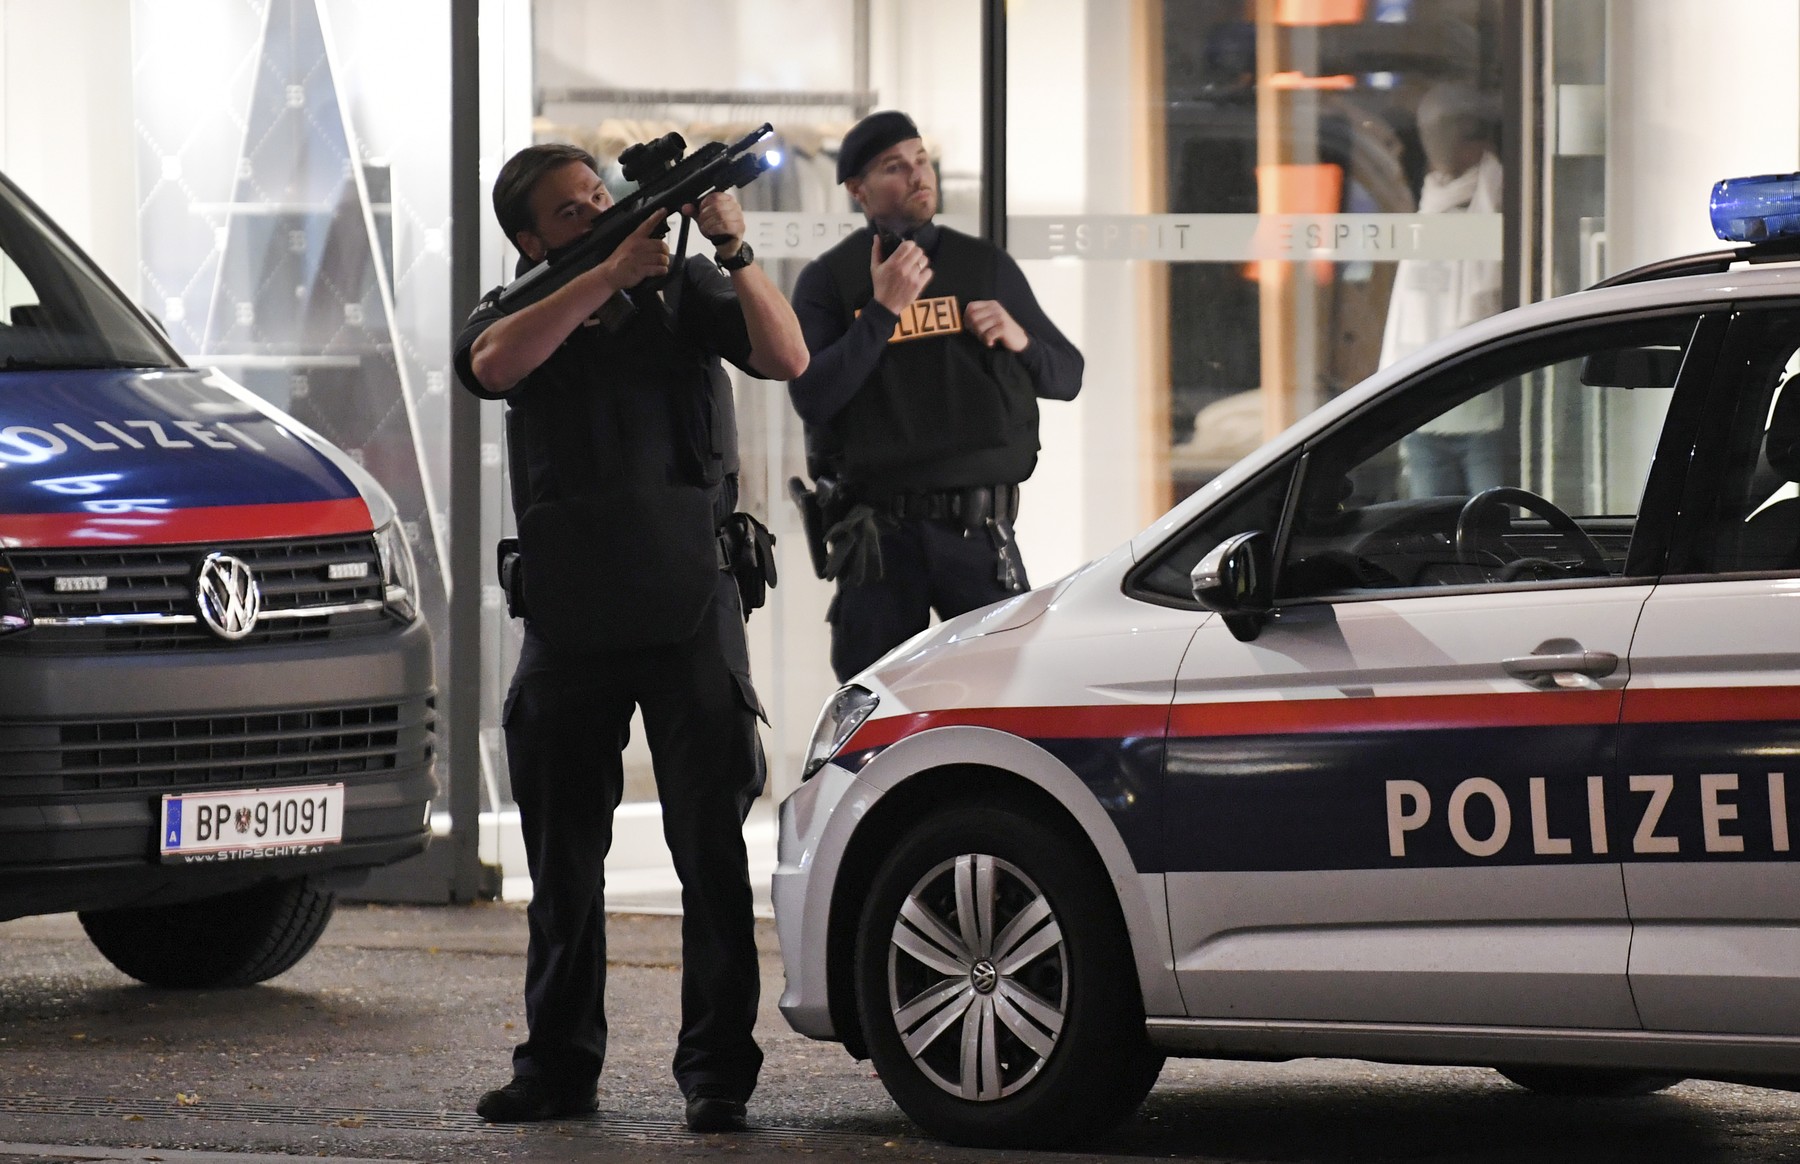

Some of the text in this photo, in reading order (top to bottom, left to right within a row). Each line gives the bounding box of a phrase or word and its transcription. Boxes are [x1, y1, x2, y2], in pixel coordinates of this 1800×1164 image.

[1049, 224, 1190, 249] ESPRIT
[1279, 223, 1422, 249] ESPRIT
[898, 299, 958, 337] LIZEI
[0, 420, 267, 456] OLIZEI
[169, 797, 328, 843] A BP 91091
[1385, 772, 1791, 857] POLIZEI
